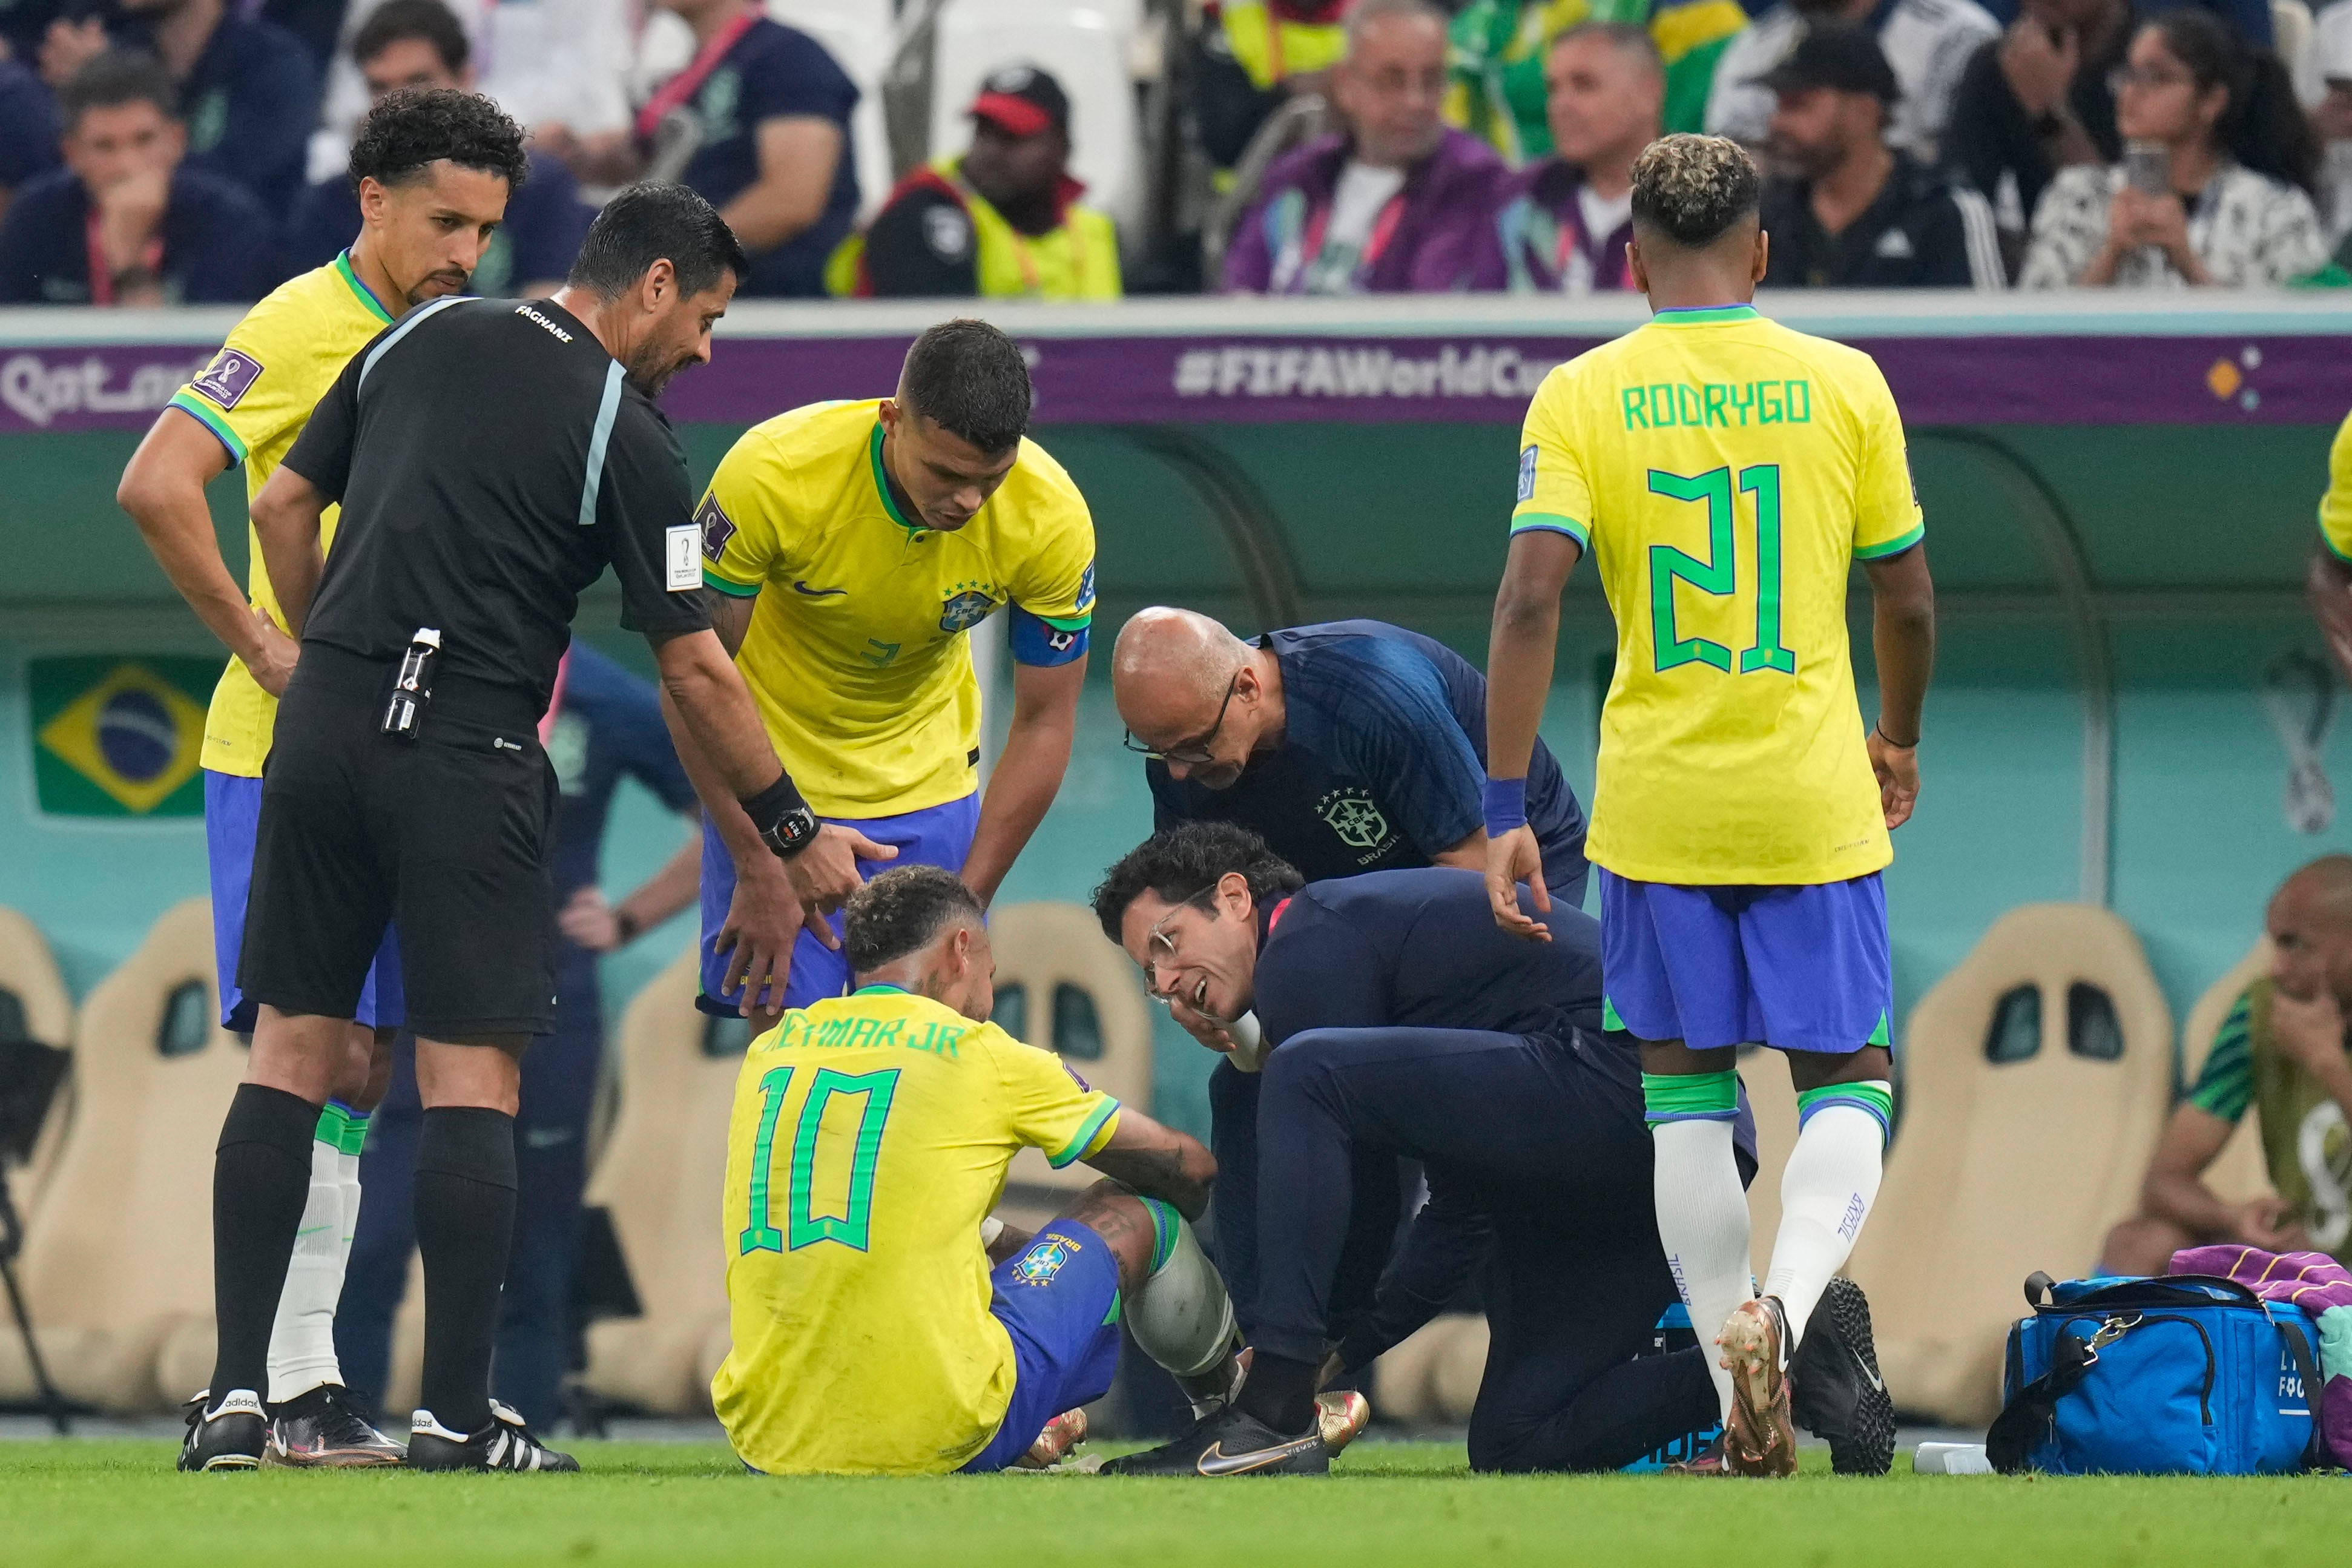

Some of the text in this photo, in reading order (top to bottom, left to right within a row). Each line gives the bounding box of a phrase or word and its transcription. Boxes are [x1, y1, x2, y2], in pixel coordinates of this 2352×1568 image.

[515, 305, 573, 343] FAGHANI
[1622, 380, 1811, 430] RODRYGO
[1647, 464, 1795, 674] 21
[1348, 814, 1365, 826] CBF
[1357, 834, 1402, 865] BRASIL
[908, 1022, 966, 1058] JR
[740, 1066, 902, 1257] 10
[1837, 1192, 1865, 1244] BRASIL
[1046, 1233, 1082, 1252] BRASIL
[225, 1398, 258, 1408] adidas
